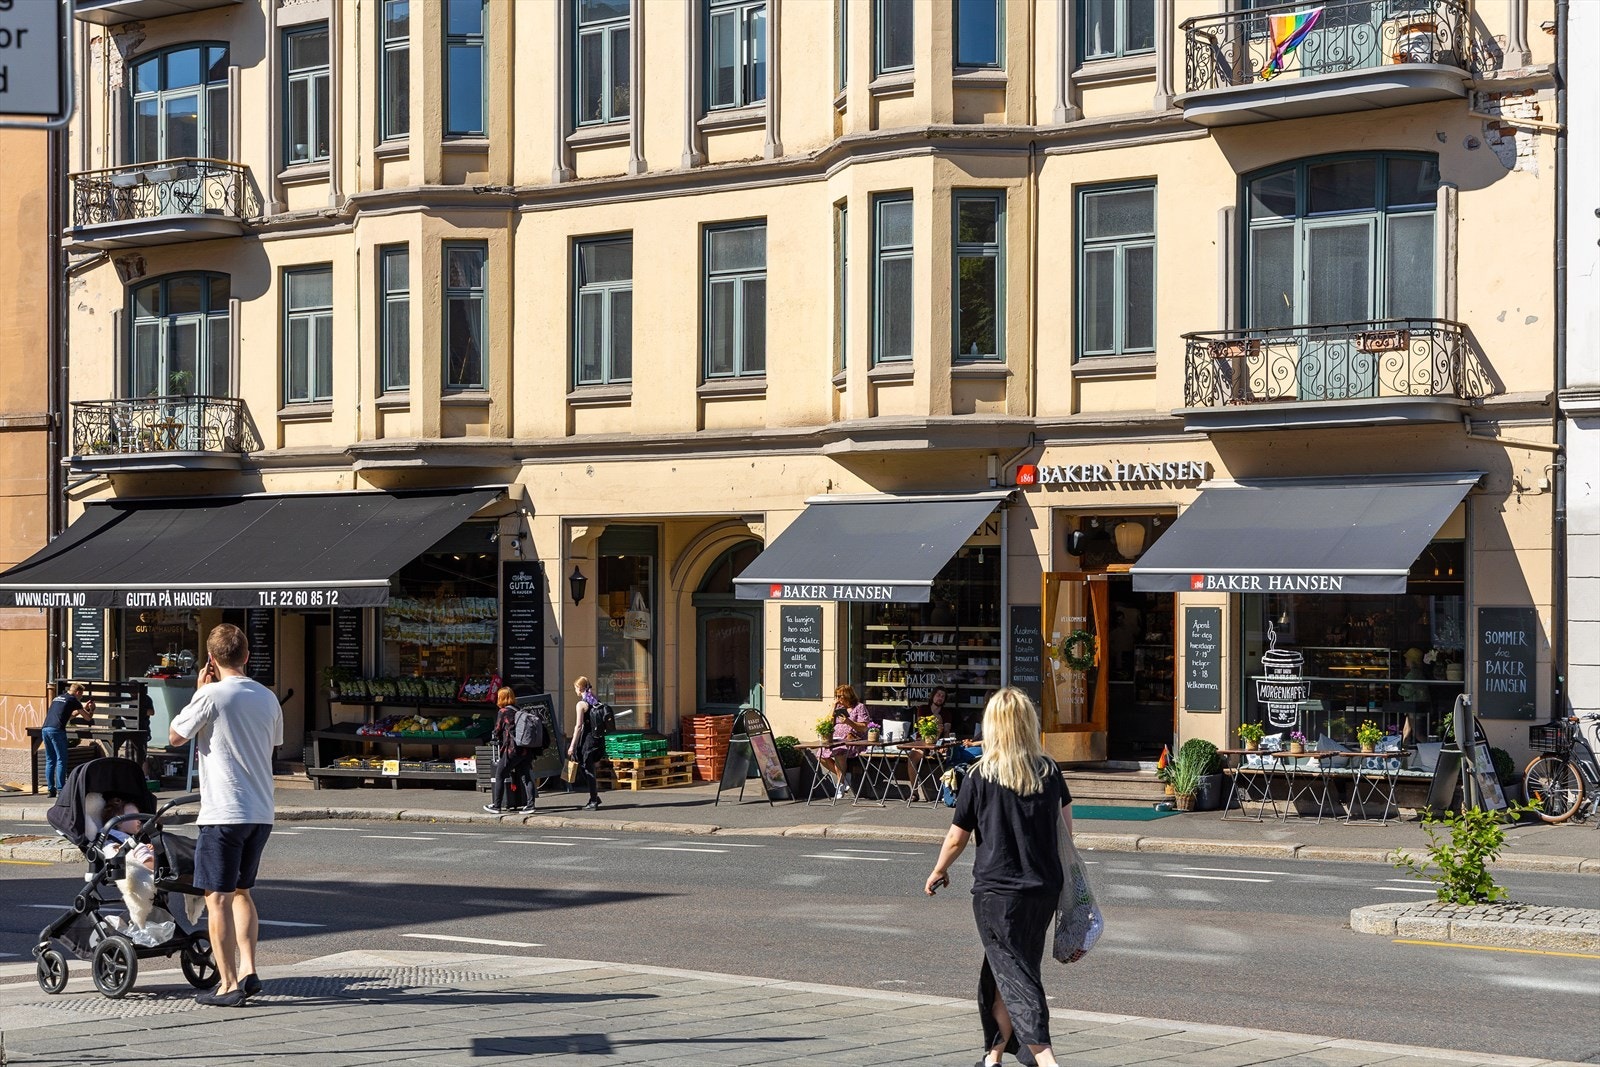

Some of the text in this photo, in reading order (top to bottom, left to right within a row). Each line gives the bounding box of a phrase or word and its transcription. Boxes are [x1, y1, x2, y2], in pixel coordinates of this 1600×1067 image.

[1037, 464, 1106, 484] BAKER
[1115, 461, 1206, 482] HANSEN
[509, 581, 536, 590] GUTTA
[1206, 575, 1263, 590] BAKER
[1268, 575, 1343, 591] HANSEN
[15, 592, 86, 607] WWW.GUTTA.NO
[127, 589, 212, 607] GUTTA PÅ HAUGEN
[258, 590, 338, 606] TLF. 22 60 85 12
[783, 585, 828, 599] BAKER
[833, 585, 893, 600] HANSEN
[1485, 631, 1528, 646] SOMMER
[905, 650, 936, 662] SOMMER
[1486, 660, 1527, 678] BAKER
[906, 674, 937, 686] BAKER
[1486, 678, 1527, 693] HANSEN
[1260, 685, 1306, 699] MORGENKAFFE
